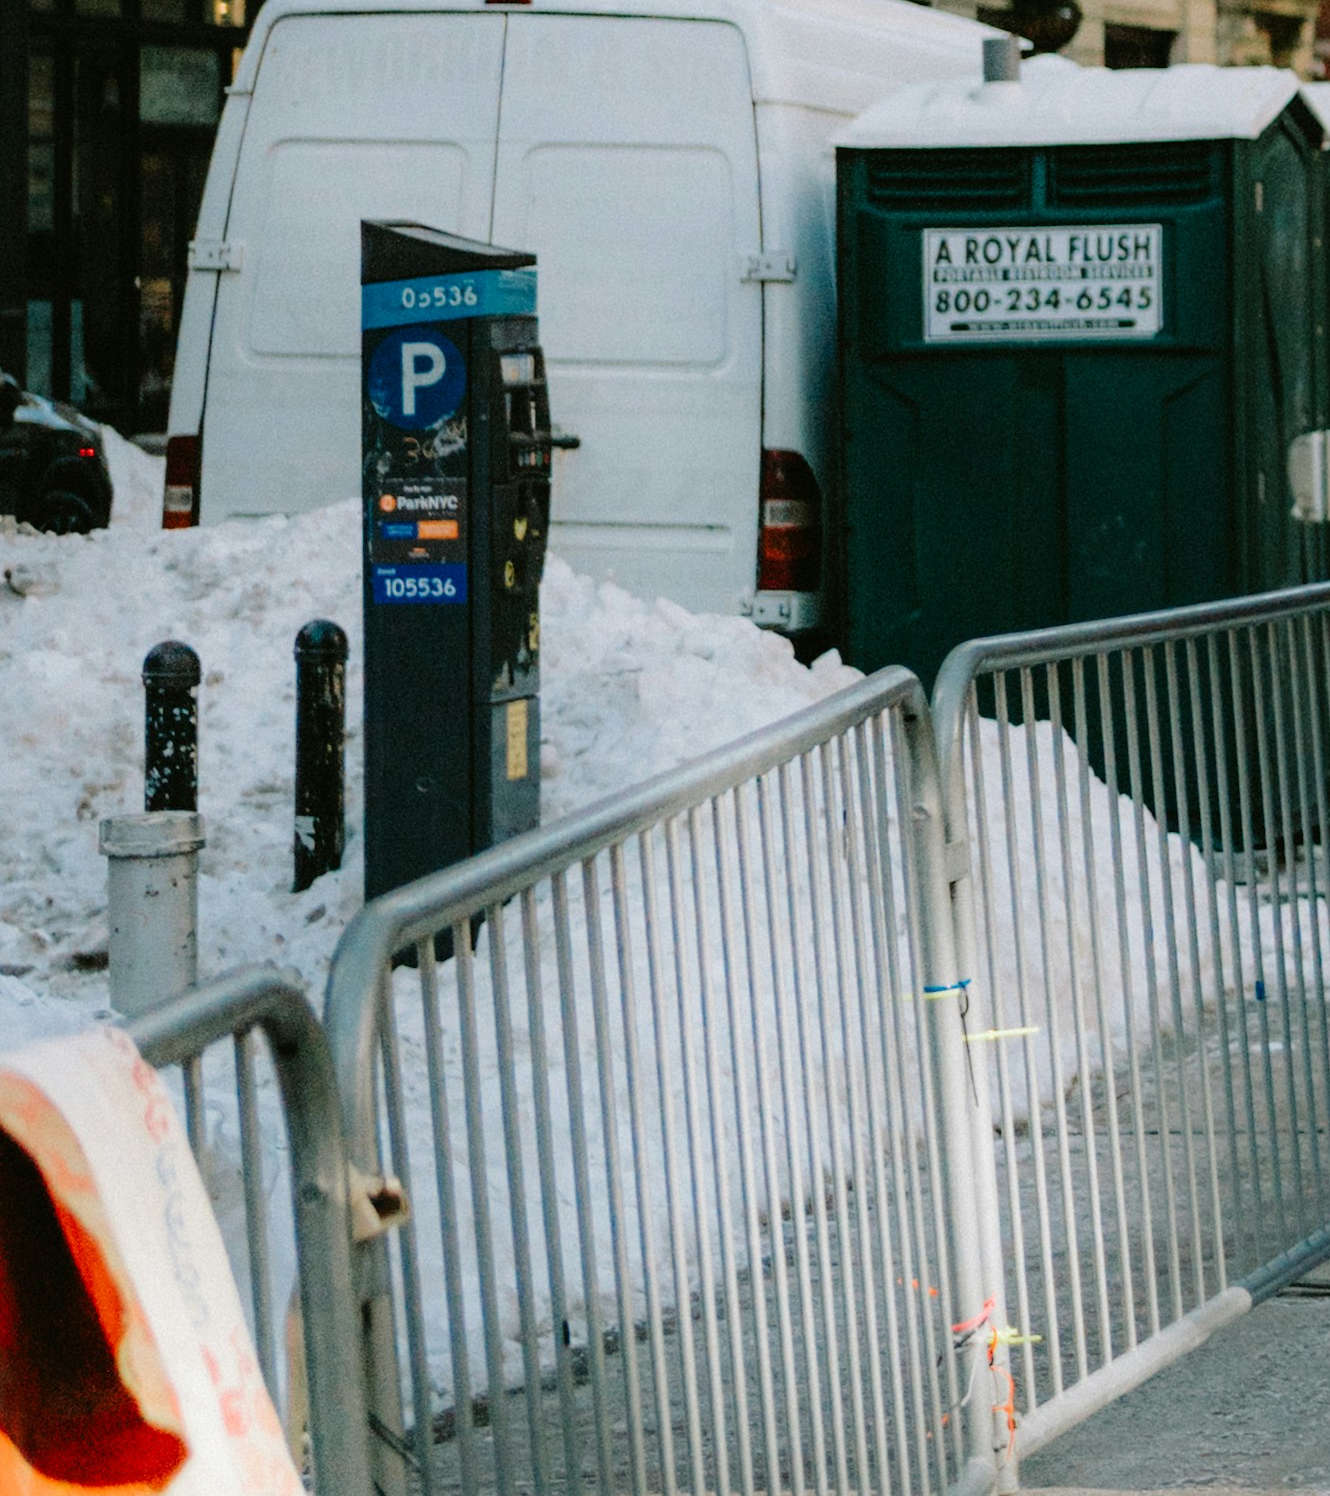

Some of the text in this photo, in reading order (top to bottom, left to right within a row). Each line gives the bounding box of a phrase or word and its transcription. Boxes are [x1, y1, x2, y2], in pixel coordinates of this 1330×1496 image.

[936, 234, 1150, 264] A ROYAL FLUSH
[936, 286, 1151, 313] 800-234-6545
[401, 342, 446, 415] P
[397, 495, 458, 510] ParkNYC
[385, 578, 456, 597] 105536
